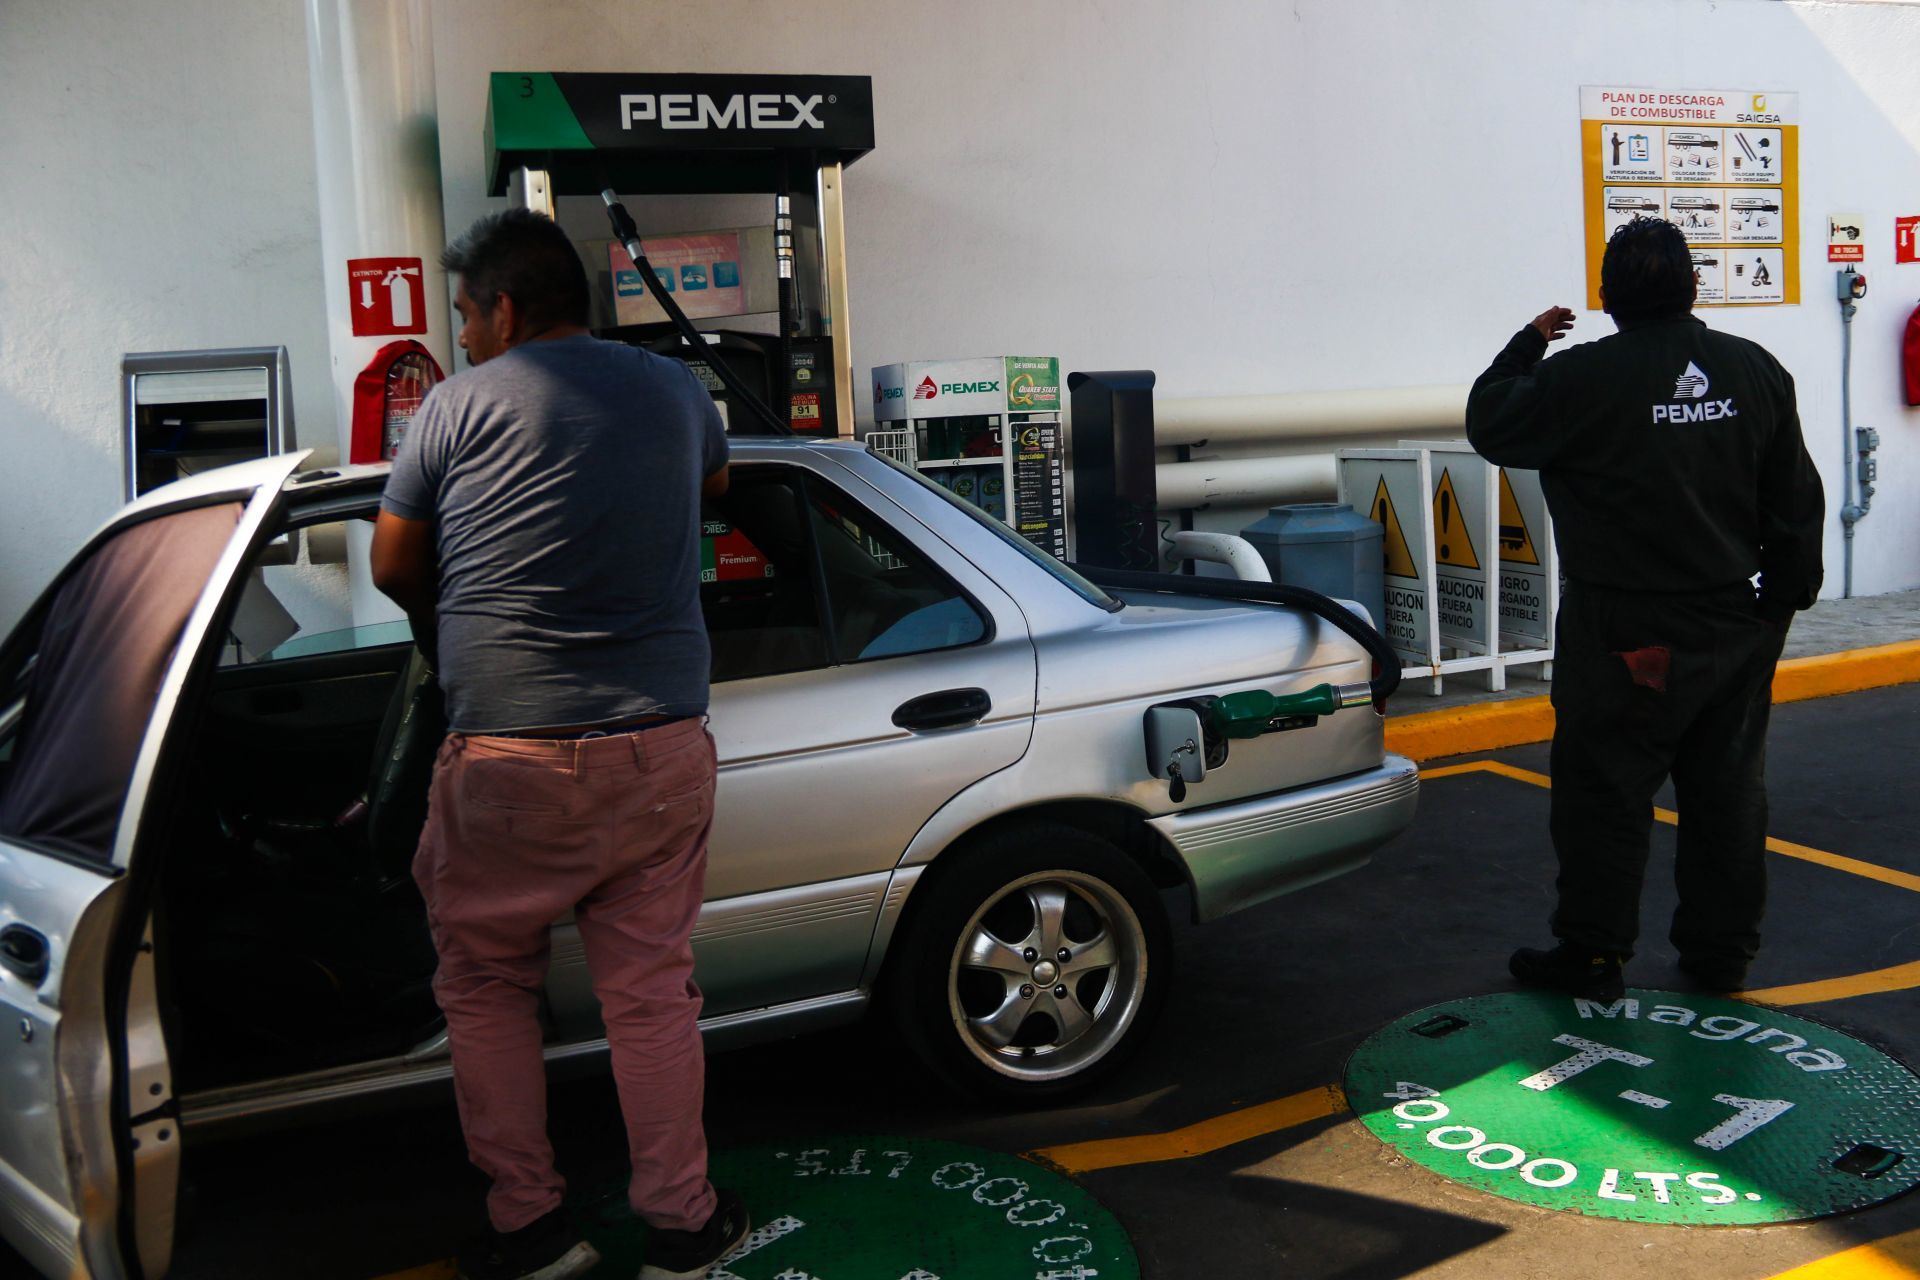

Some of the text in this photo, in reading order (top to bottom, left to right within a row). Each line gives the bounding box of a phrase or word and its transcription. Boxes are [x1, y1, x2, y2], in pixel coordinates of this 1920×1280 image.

[519, 76, 535, 99] 3
[1602, 92, 1725, 107] PLAN DE DESCARGA
[620, 94, 825, 130] PEMEX
[1611, 106, 1717, 120] DE COMBUSTIBLE
[352, 269, 384, 278] EXTINTOR
[884, 387, 904, 399] PEMEX
[941, 380, 1000, 395] PEMEX
[797, 406, 810, 414] 91
[1652, 398, 1733, 424] PEMEX
[720, 555, 757, 565] Premium
[702, 570, 713, 581] 87
[1437, 579, 1484, 600] AUCION
[1500, 576, 1530, 592] IGRO
[1384, 590, 1424, 611] UCION
[1442, 599, 1473, 614] FUERA
[1499, 591, 1539, 608] RGANDO
[1438, 611, 1473, 629] ERVICIO
[1499, 606, 1538, 622] USTIBLE
[1385, 624, 1416, 640] RVICIO
[1572, 997, 1849, 1074] Magna
